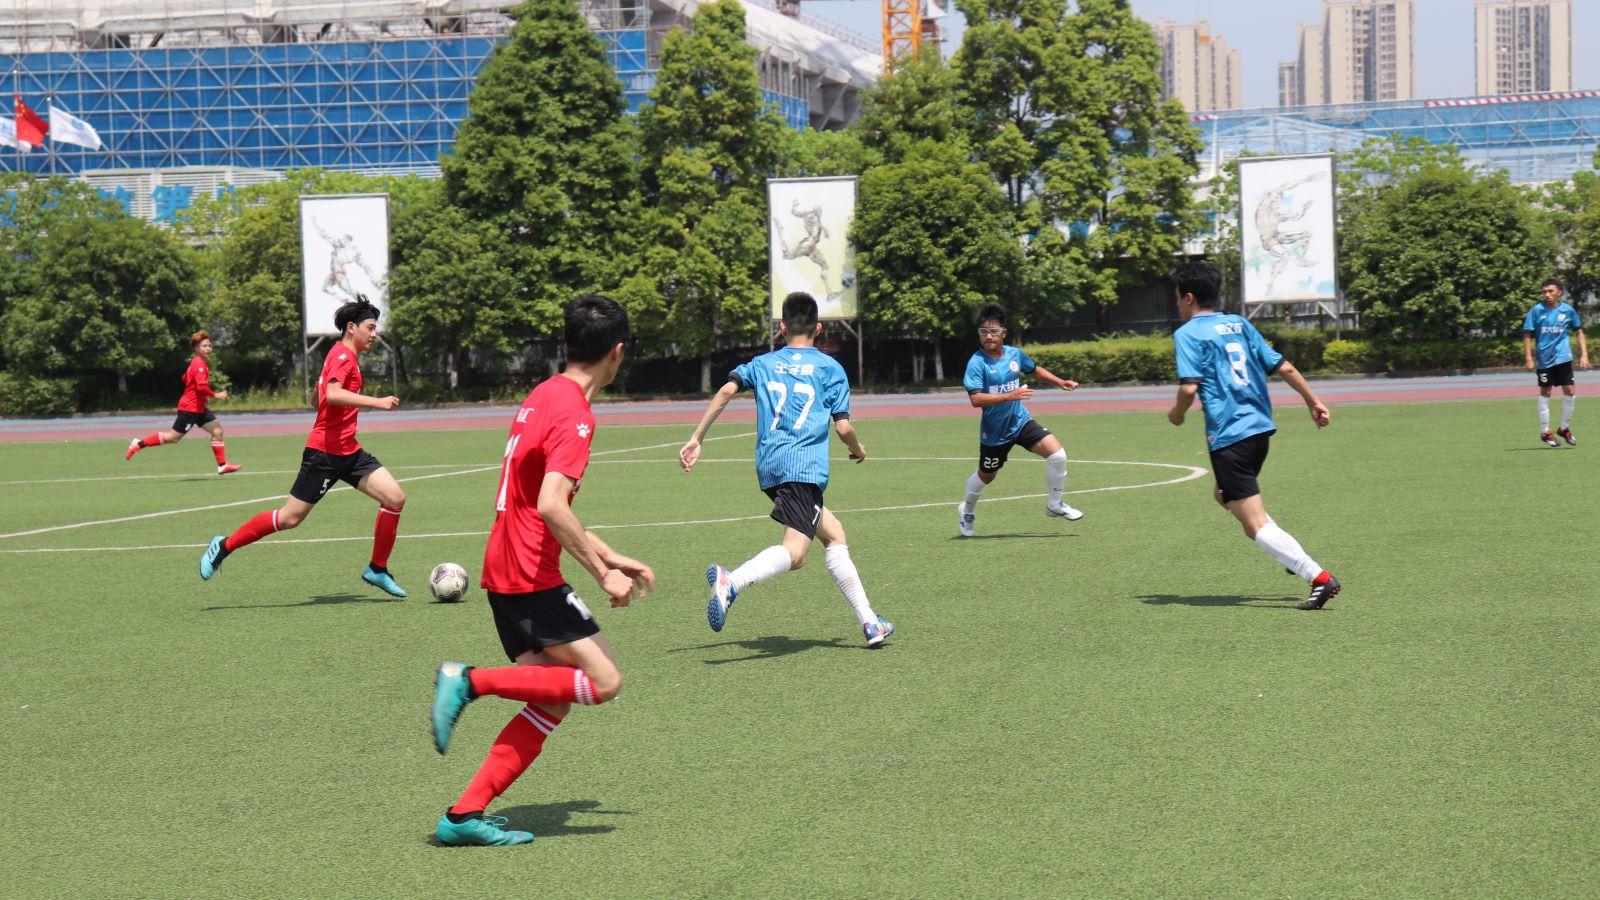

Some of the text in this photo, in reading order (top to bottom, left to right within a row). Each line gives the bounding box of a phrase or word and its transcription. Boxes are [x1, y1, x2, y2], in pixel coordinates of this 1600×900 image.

[1225, 342, 1250, 386] 8
[767, 381, 816, 432] 77
[983, 457, 999, 469] 22
[319, 478, 330, 494] 5
